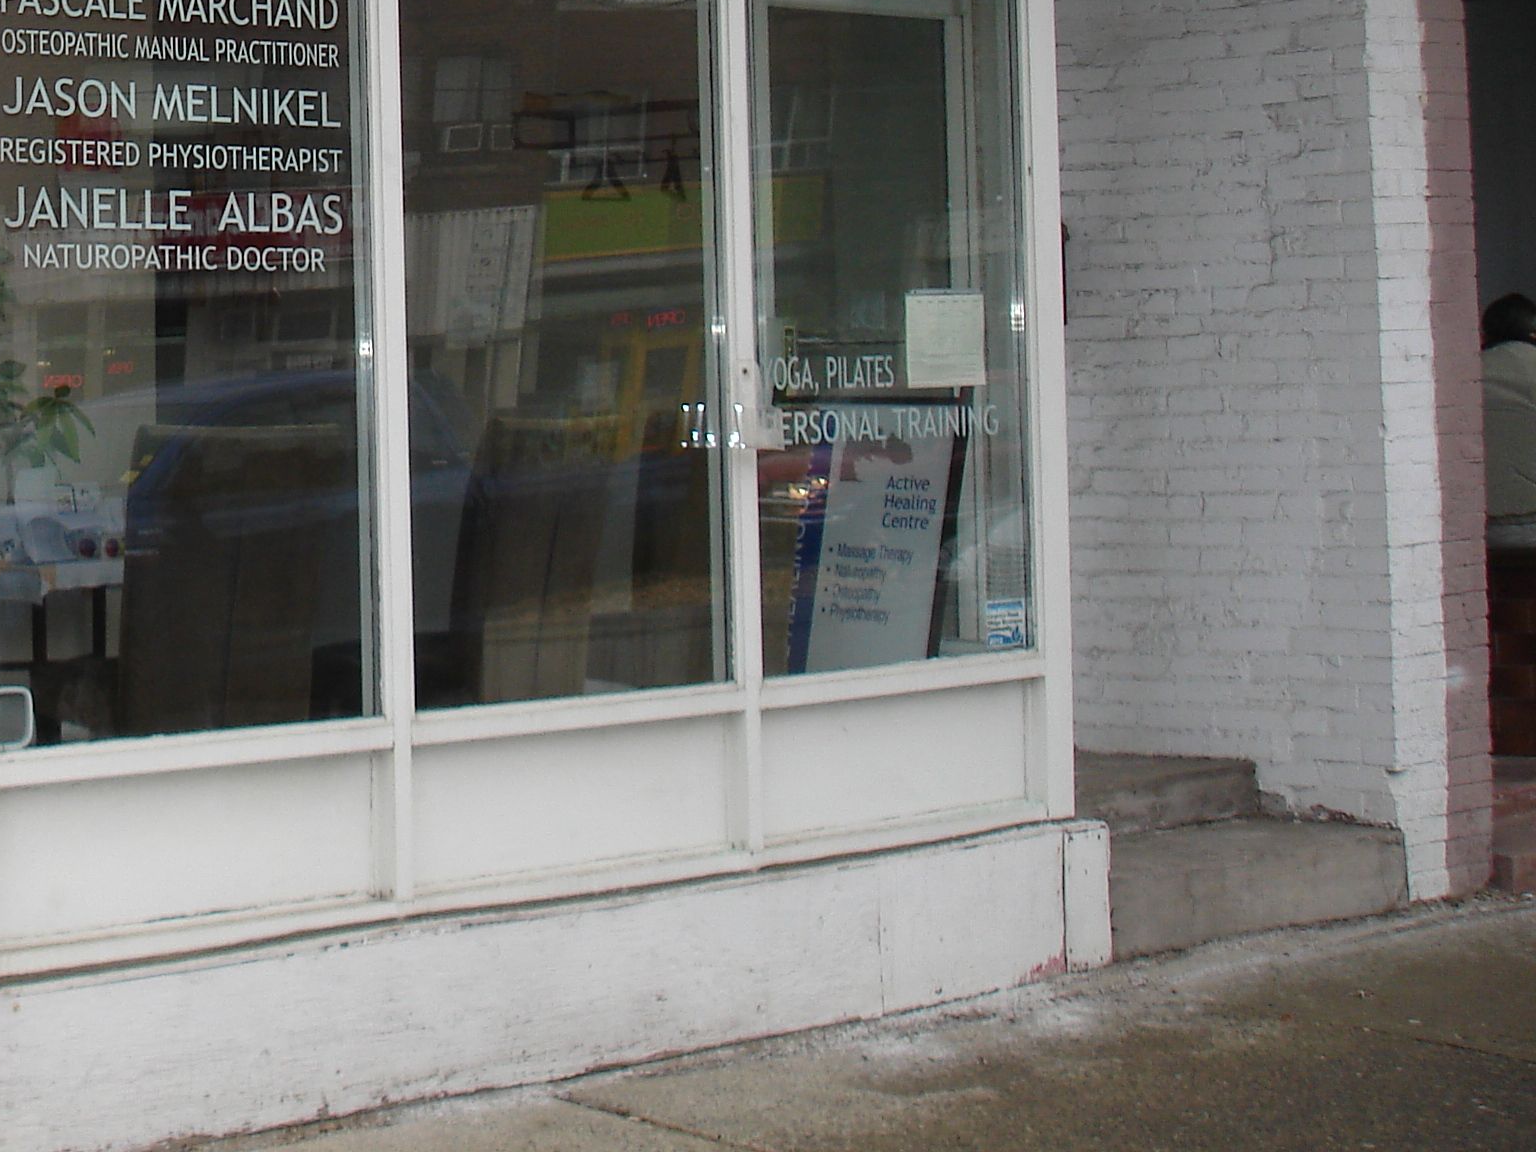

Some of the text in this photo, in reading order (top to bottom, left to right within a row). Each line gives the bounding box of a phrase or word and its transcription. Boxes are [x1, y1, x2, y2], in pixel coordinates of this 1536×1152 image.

[1, 28, 340, 68] OSTEOPATHIC MANUAL PRACTITIONER
[2, 76, 342, 128] JASON MELNIKEL
[0, 136, 343, 174] REGISTERED PHYSIOTHERAPIST
[4, 186, 344, 235] JANELLE ALBAS
[23, 243, 326, 273] NATUROPATHIC DOCTOR
[826, 355, 895, 389] PILATES
[891, 404, 1000, 438] TRAINING
[886, 475, 930, 491] Active
[882, 512, 930, 530] Centre
[884, 494, 937, 514] Healing
